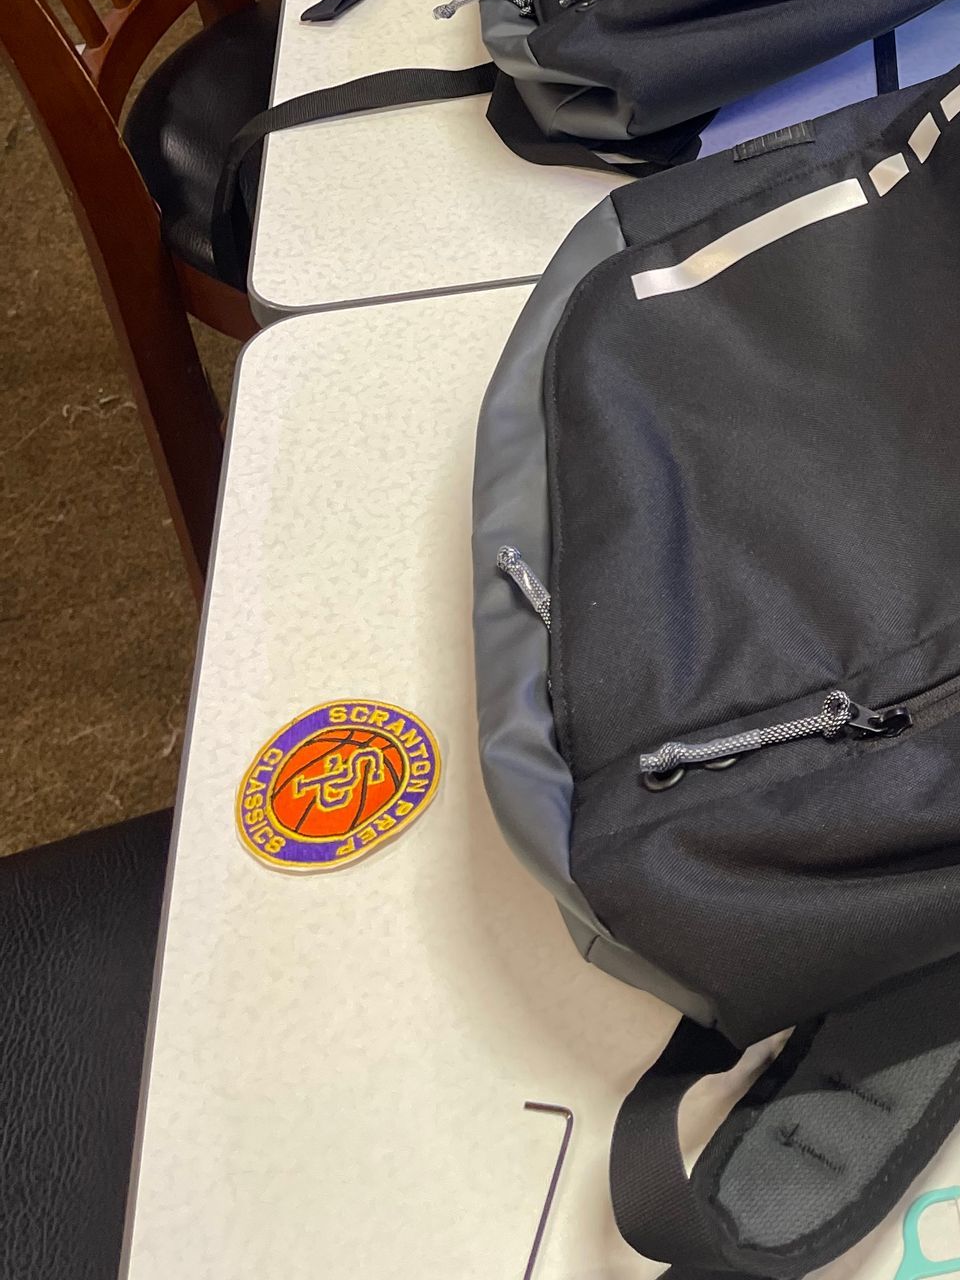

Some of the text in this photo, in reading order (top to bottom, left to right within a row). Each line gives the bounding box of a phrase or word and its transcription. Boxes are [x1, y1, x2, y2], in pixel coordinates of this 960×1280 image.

[243, 747, 287, 854] CLASSICS
[329, 706, 431, 856] SCRANTON PREP
